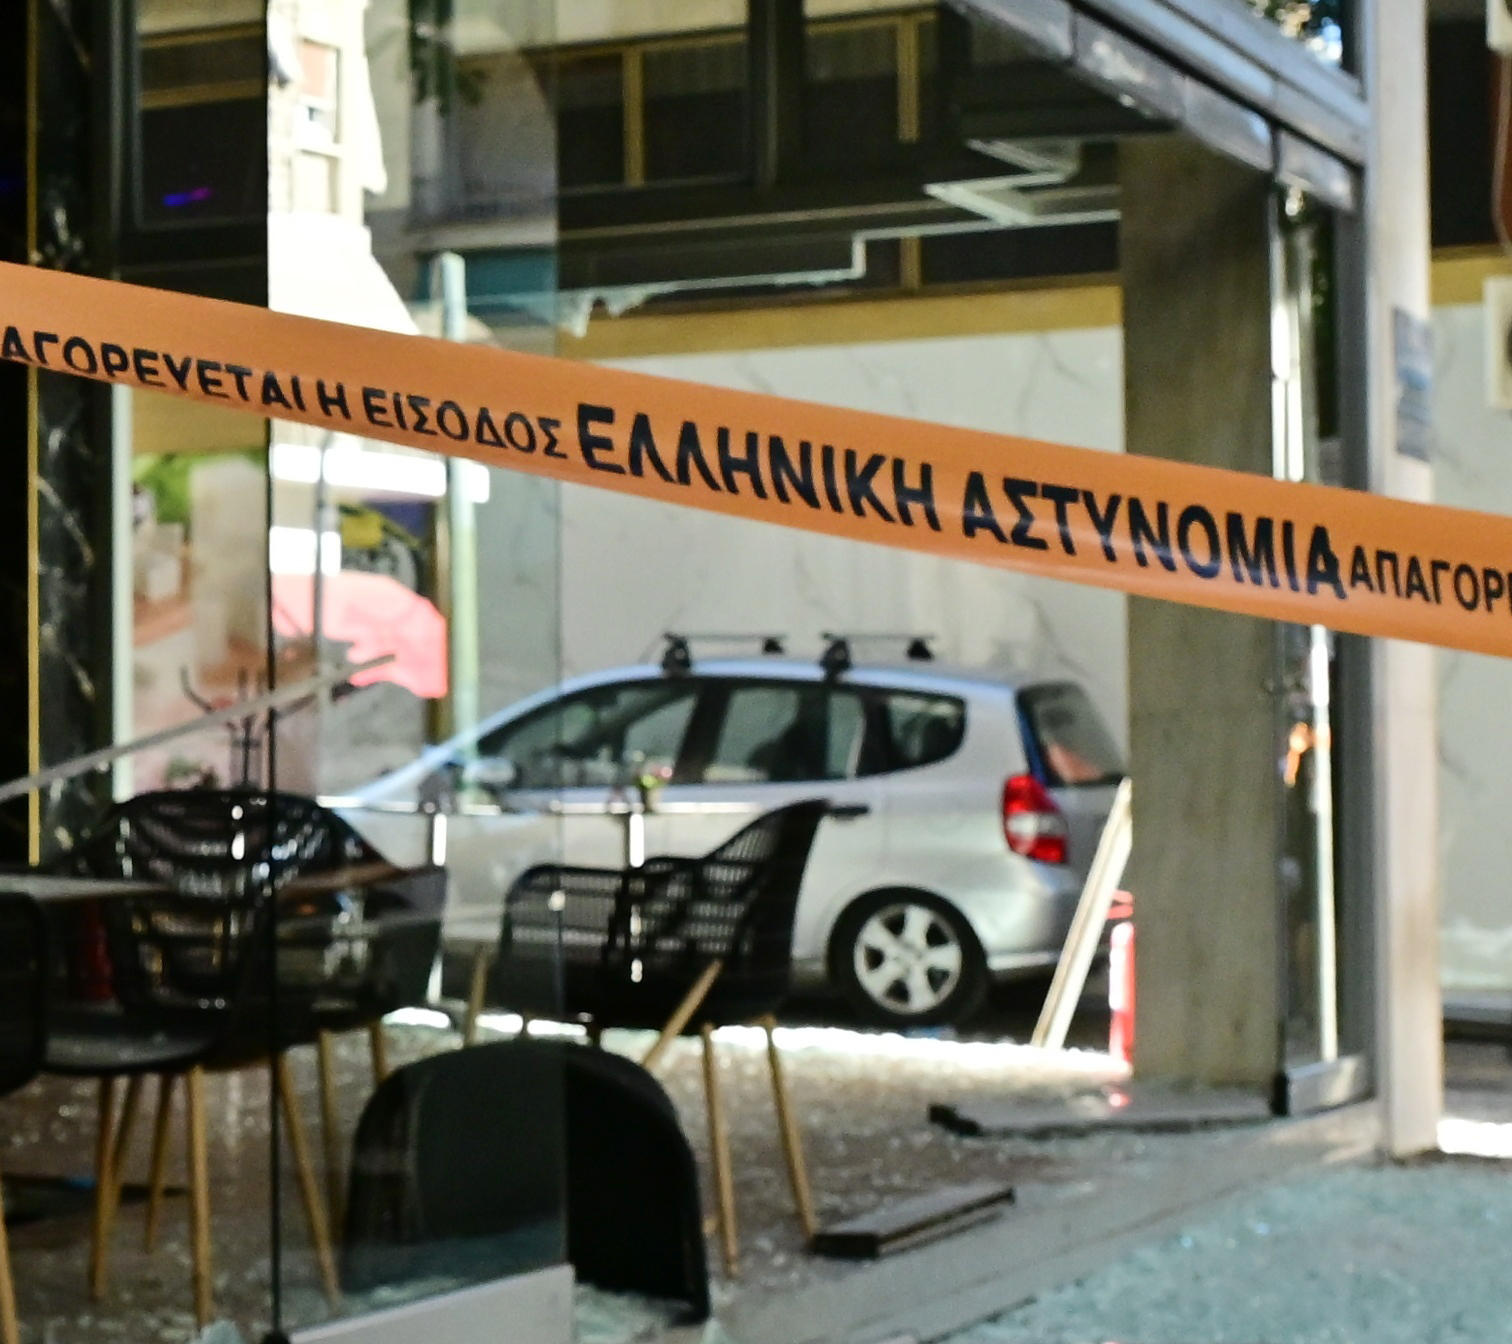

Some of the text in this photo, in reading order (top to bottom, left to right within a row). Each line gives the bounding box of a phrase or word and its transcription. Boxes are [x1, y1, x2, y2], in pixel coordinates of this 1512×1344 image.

[316, 379, 351, 421] Η
[363, 386, 571, 460] ΕΙΣΟΔΟΣ
[577, 402, 942, 538] ΕΛΛΗΝΙΚΗ
[961, 470, 1348, 601] ΑΣΤΥΝΟΜΙΑ
